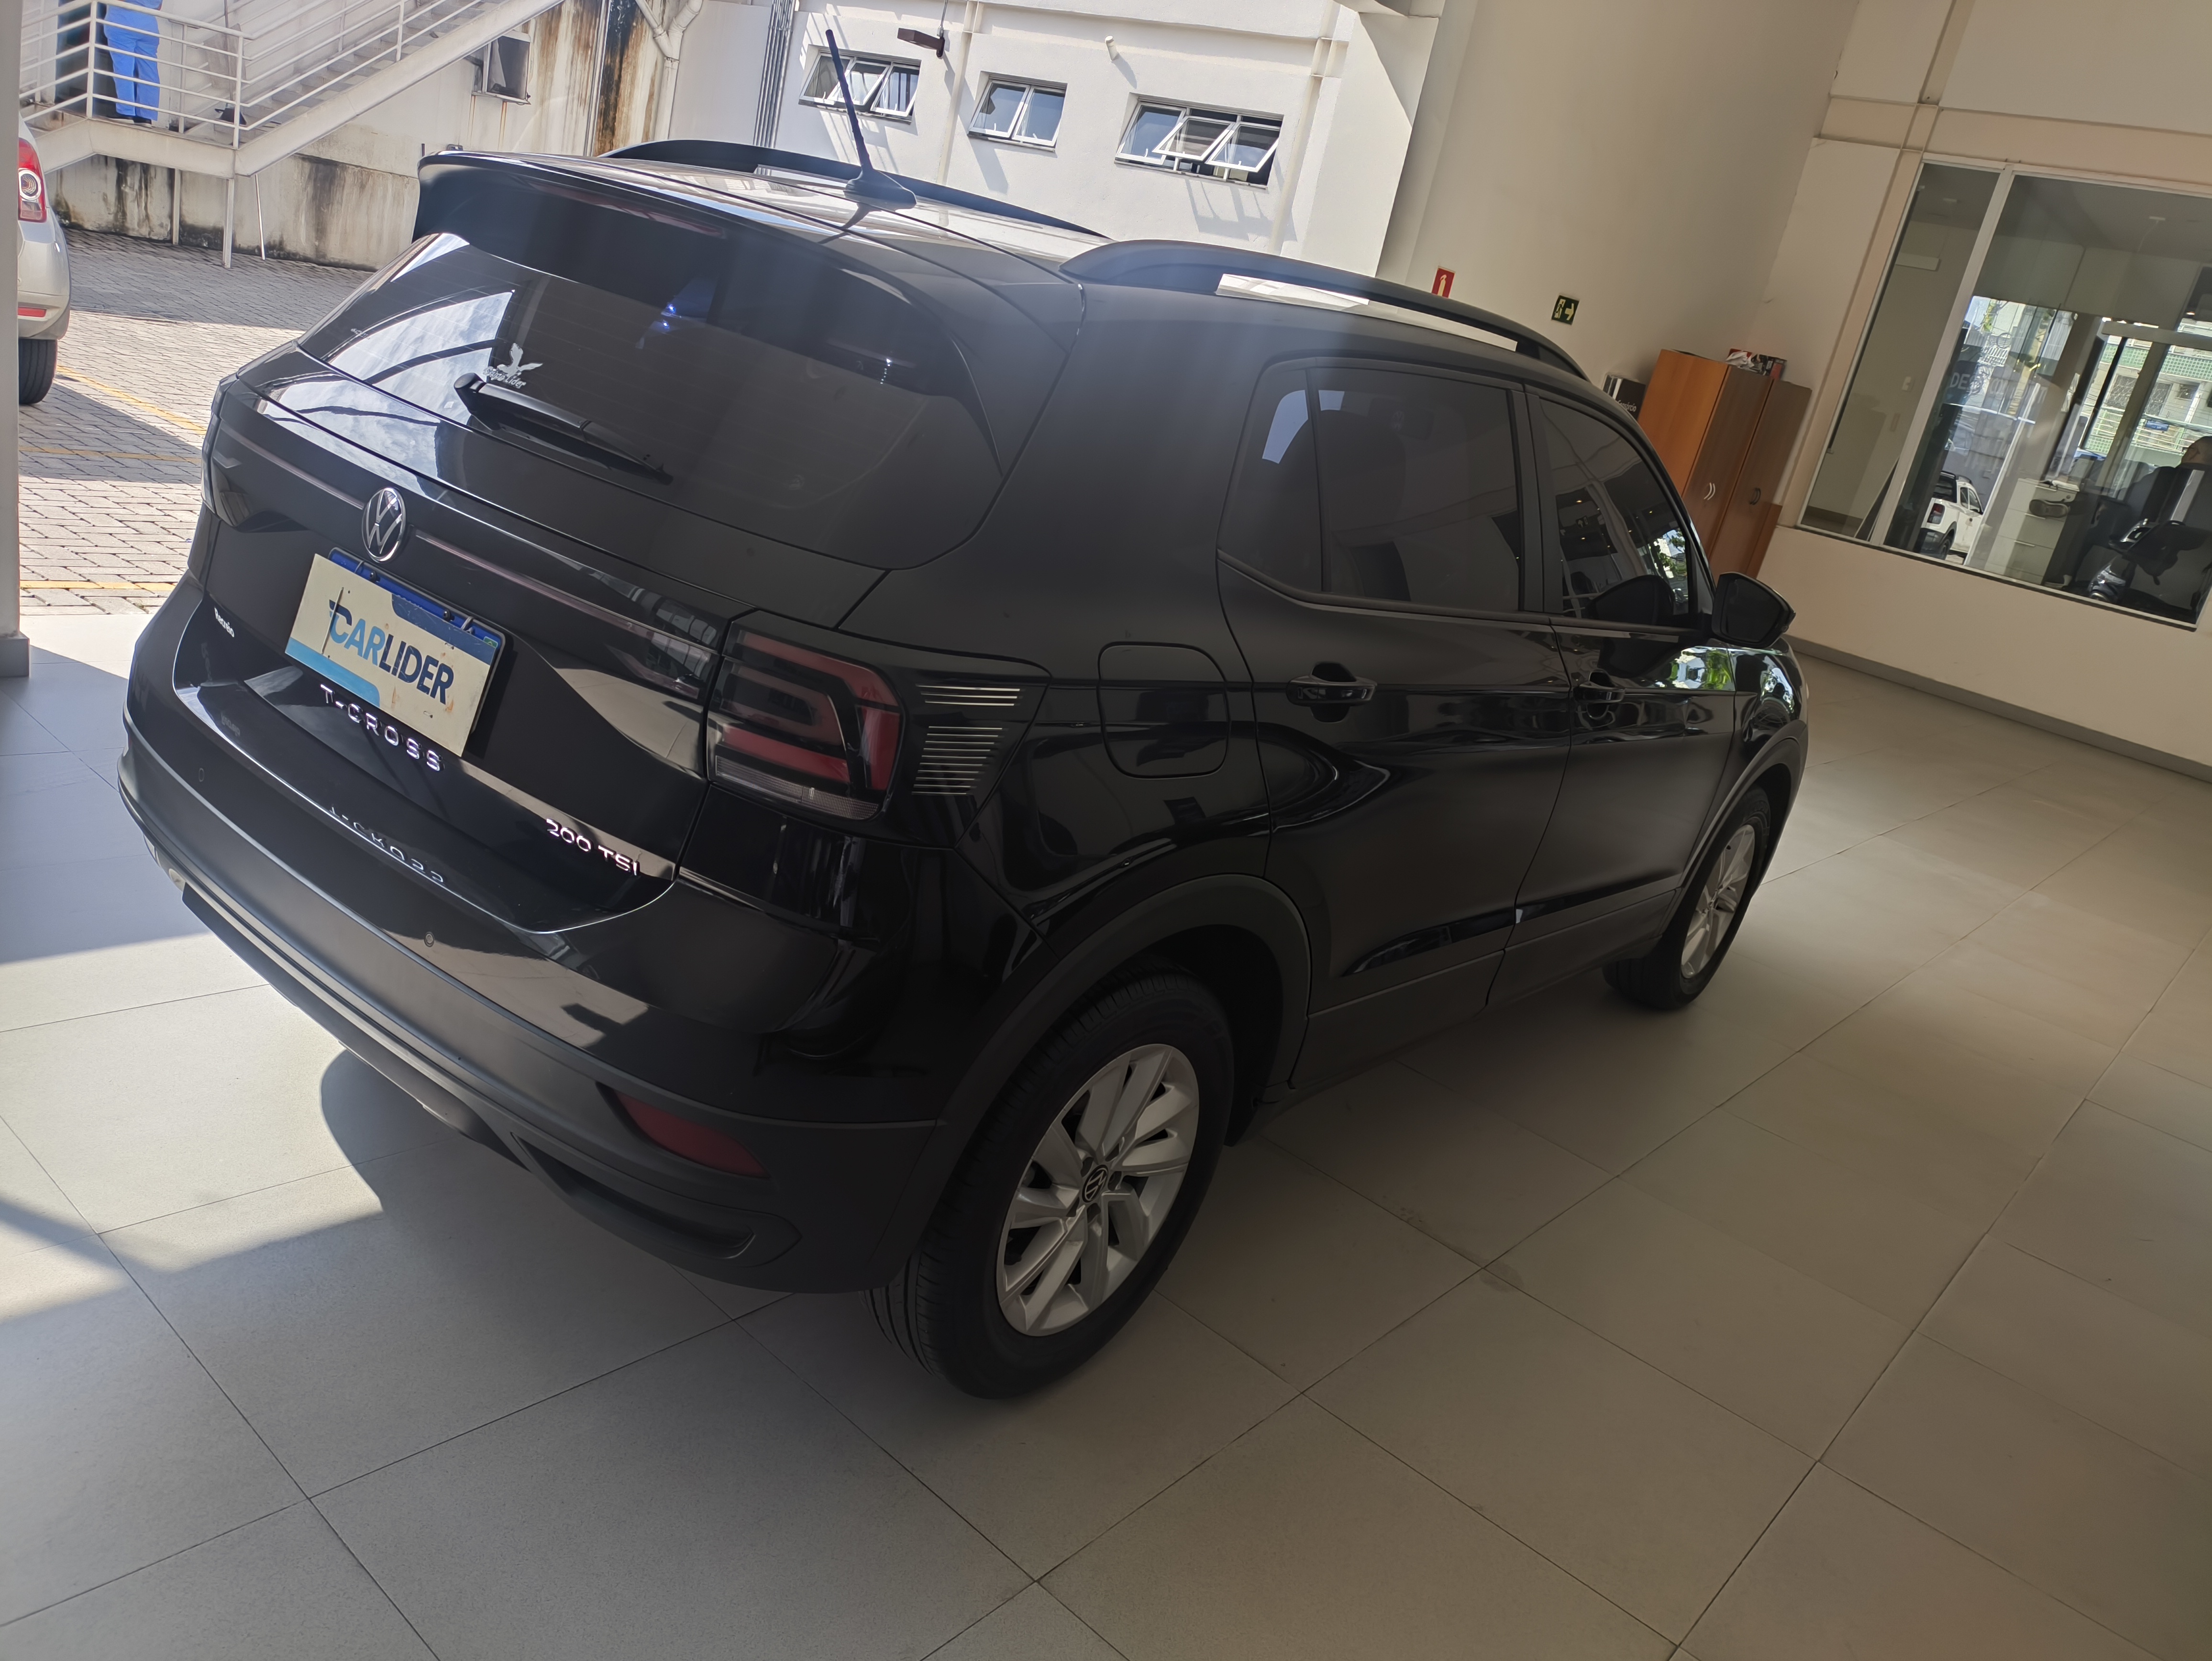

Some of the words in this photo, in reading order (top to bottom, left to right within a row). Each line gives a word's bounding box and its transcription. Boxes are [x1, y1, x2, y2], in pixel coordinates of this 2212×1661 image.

[329, 599, 454, 705] CARLIDER
[320, 684, 441, 772] T-CROSS
[546, 818, 591, 852] 200
[598, 845, 637, 876] TSI
